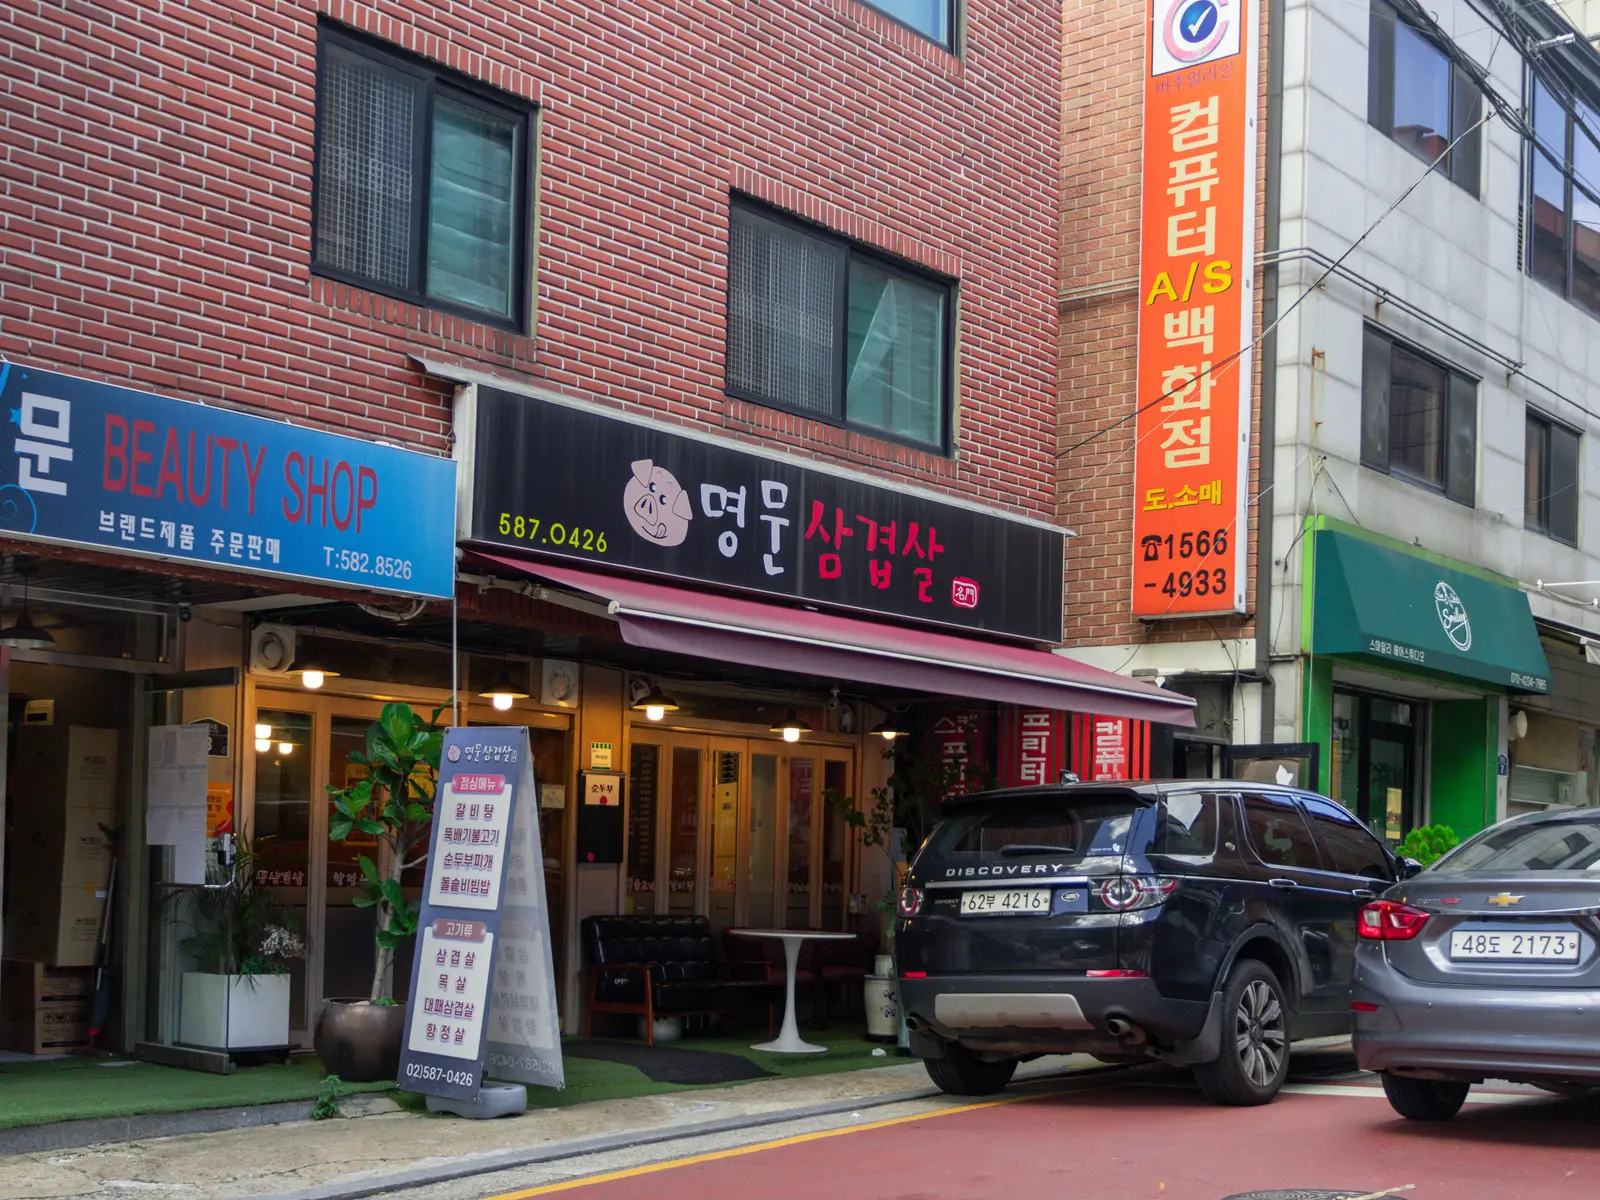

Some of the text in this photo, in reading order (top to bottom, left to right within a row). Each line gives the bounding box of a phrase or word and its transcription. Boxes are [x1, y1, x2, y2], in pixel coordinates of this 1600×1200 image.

[1167, 95, 1219, 257] 컴퓨터
[1146, 260, 1232, 305] A/S
[1160, 305, 1217, 469] 백화점
[14, 391, 73, 496] 문
[102, 413, 378, 535] BEAUTY SHOP
[1143, 480, 1223, 511] 도.소매
[99, 510, 281, 565] 브랜드제품 주문판매
[498, 512, 608, 553] 587.0426
[700, 480, 945, 604] 명문 삼겹살
[1163, 528, 1228, 560] 1566
[323, 546, 413, 581] T:582.8526
[1144, 568, 1227, 598] -4933
[1020, 713, 1051, 786] 프린터
[460, 776, 497, 791] 점심메뉴
[591, 783, 614, 795] 순두부
[455, 802, 495, 820] 갈비탕
[443, 827, 500, 845] 뚝배기불고기
[443, 851, 494, 870] 순두부찌개
[945, 863, 1063, 877] DISCOVERY
[440, 876, 491, 895] 돌솥비빔밥
[968, 892, 1042, 910] 62부 4216
[445, 922, 473, 937] 고기류
[1461, 935, 1566, 955] 48도 2173
[436, 948, 476, 967] 삼겹살
[438, 974, 468, 991] 목살
[423, 997, 476, 1019] 대패삼겹살
[425, 1022, 467, 1043] 항정살
[406, 1062, 474, 1087] 02)587-0426
